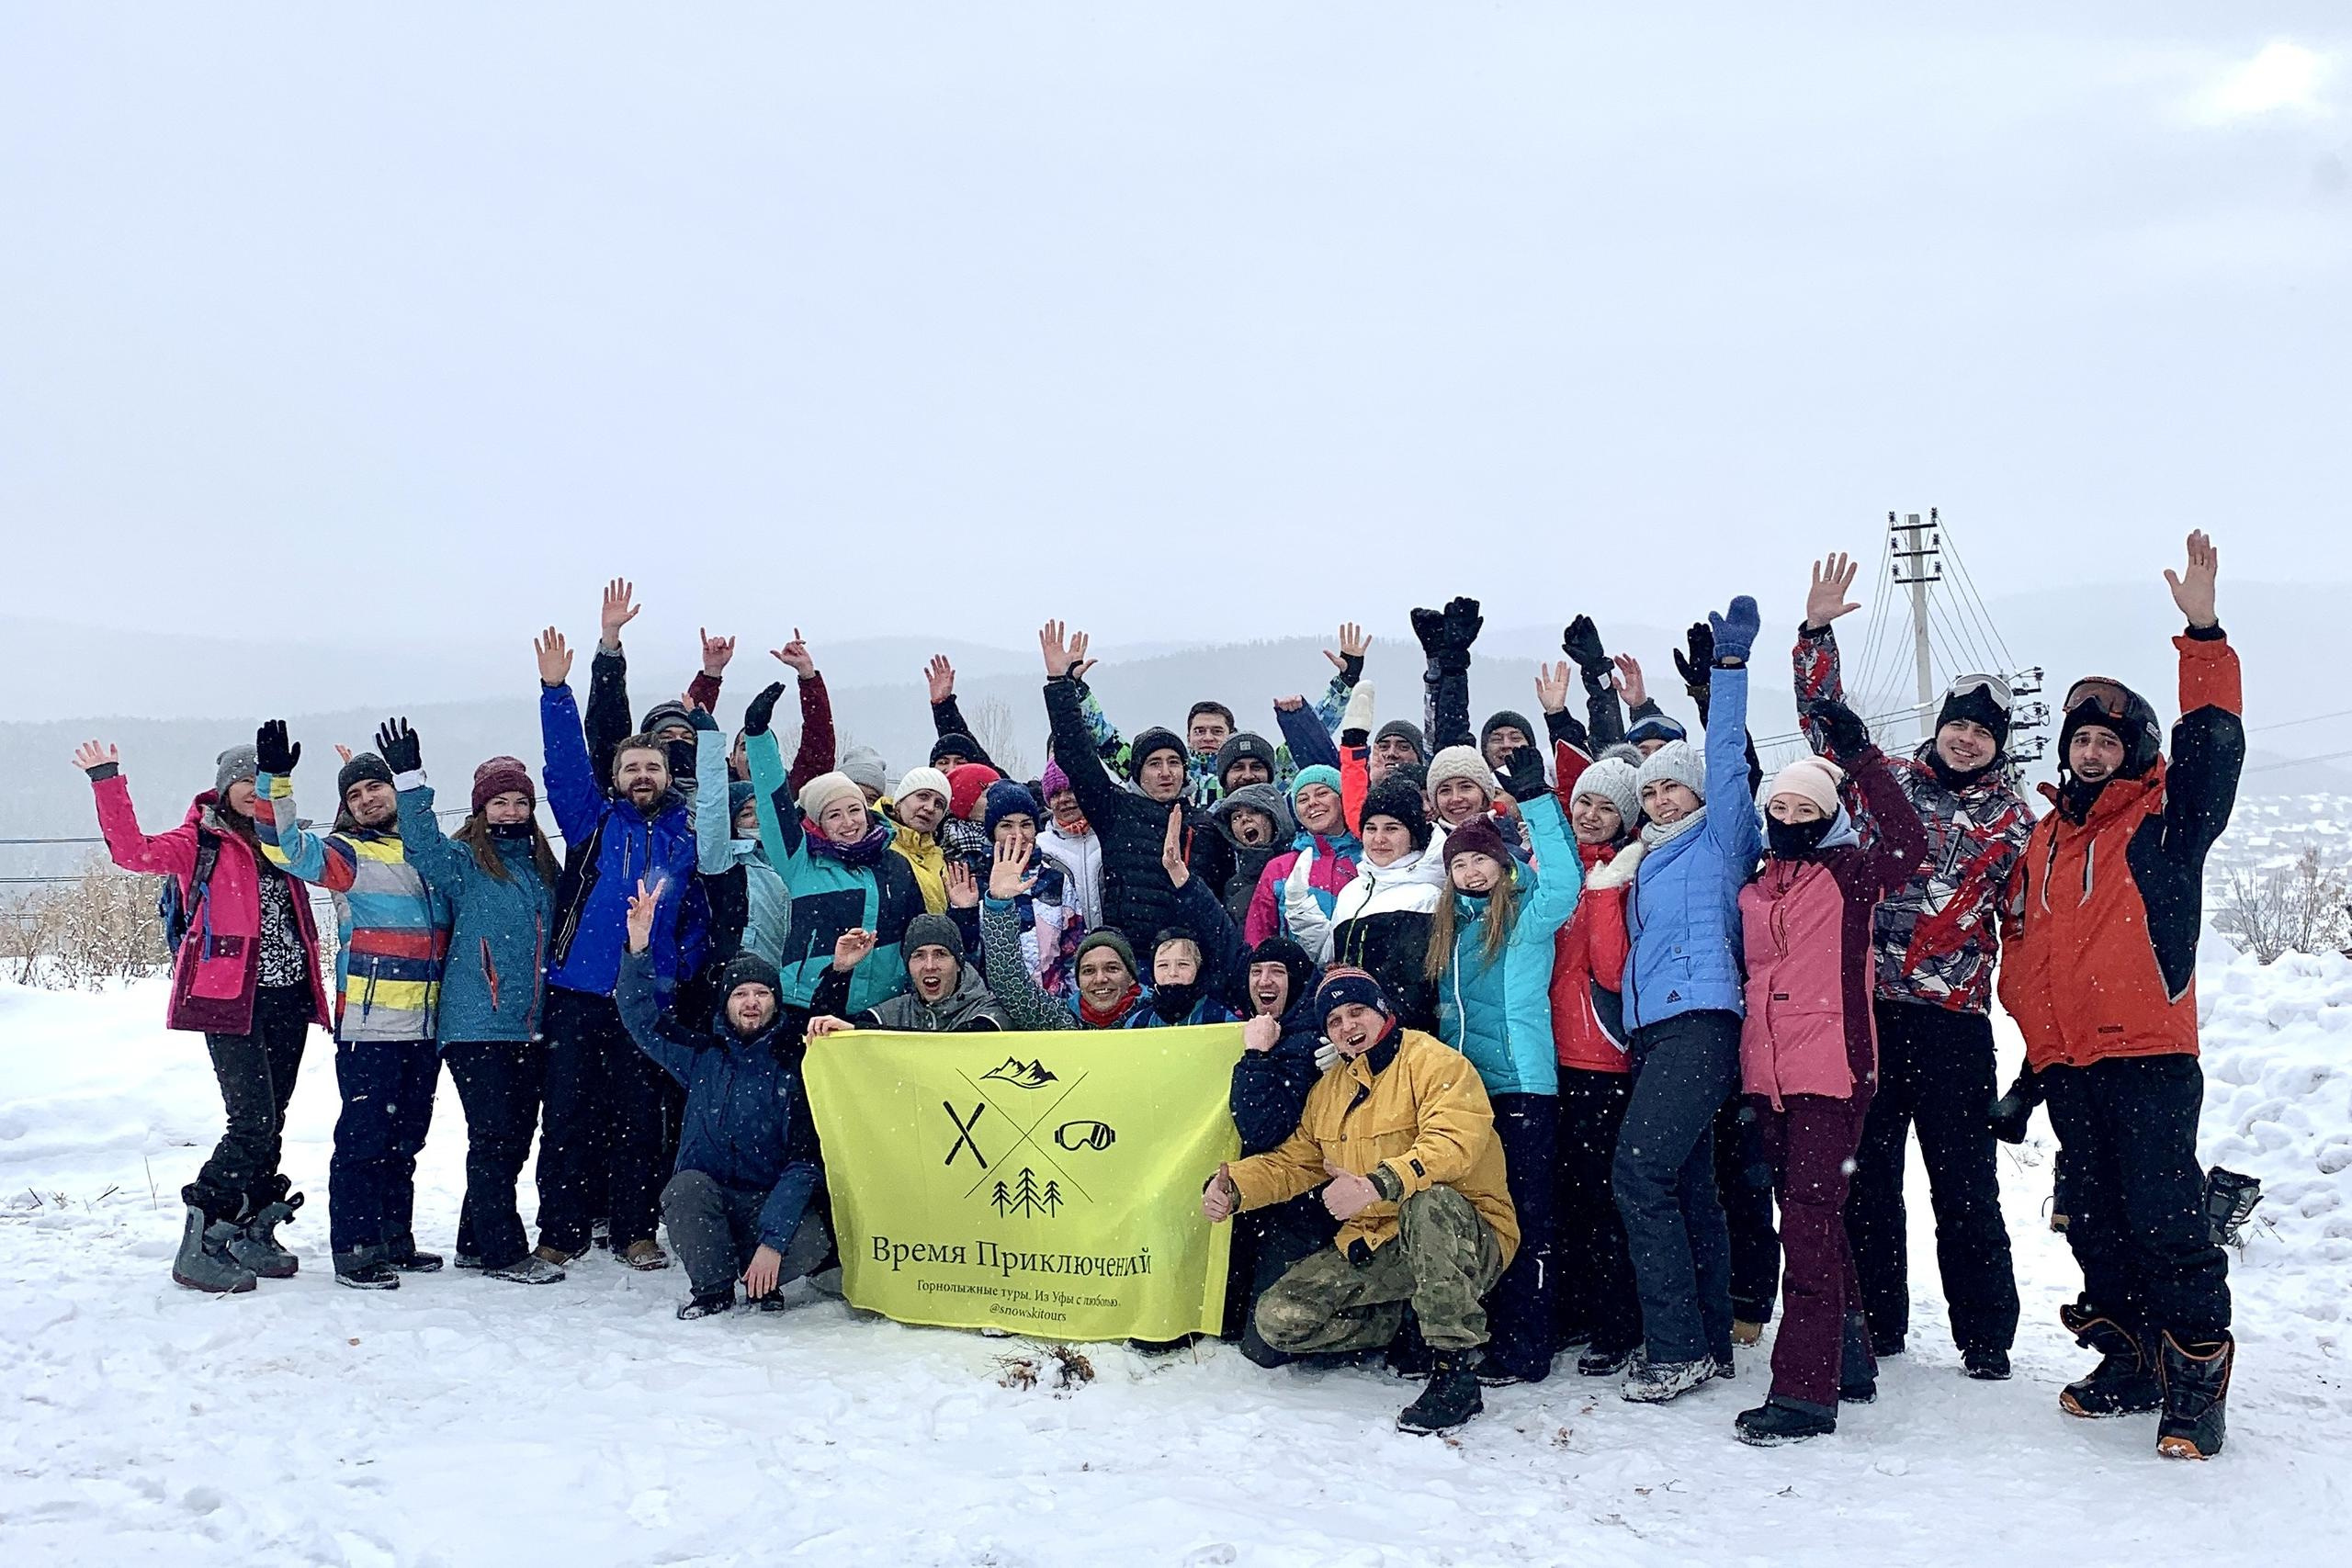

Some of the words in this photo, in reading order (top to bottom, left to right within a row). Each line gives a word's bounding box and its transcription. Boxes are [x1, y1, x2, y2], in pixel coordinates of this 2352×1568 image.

[871, 1235, 967, 1271] Время
[975, 1240, 1152, 1278] Приключений
[917, 1280, 999, 1297] Горнолыжные
[1001, 1288, 1032, 1303] туры.
[1035, 1289, 1049, 1303] Из
[1052, 1291, 1075, 1307] Уфы
[1076, 1297, 1081, 1305] с
[989, 1303, 1067, 1322] @snowskitours
